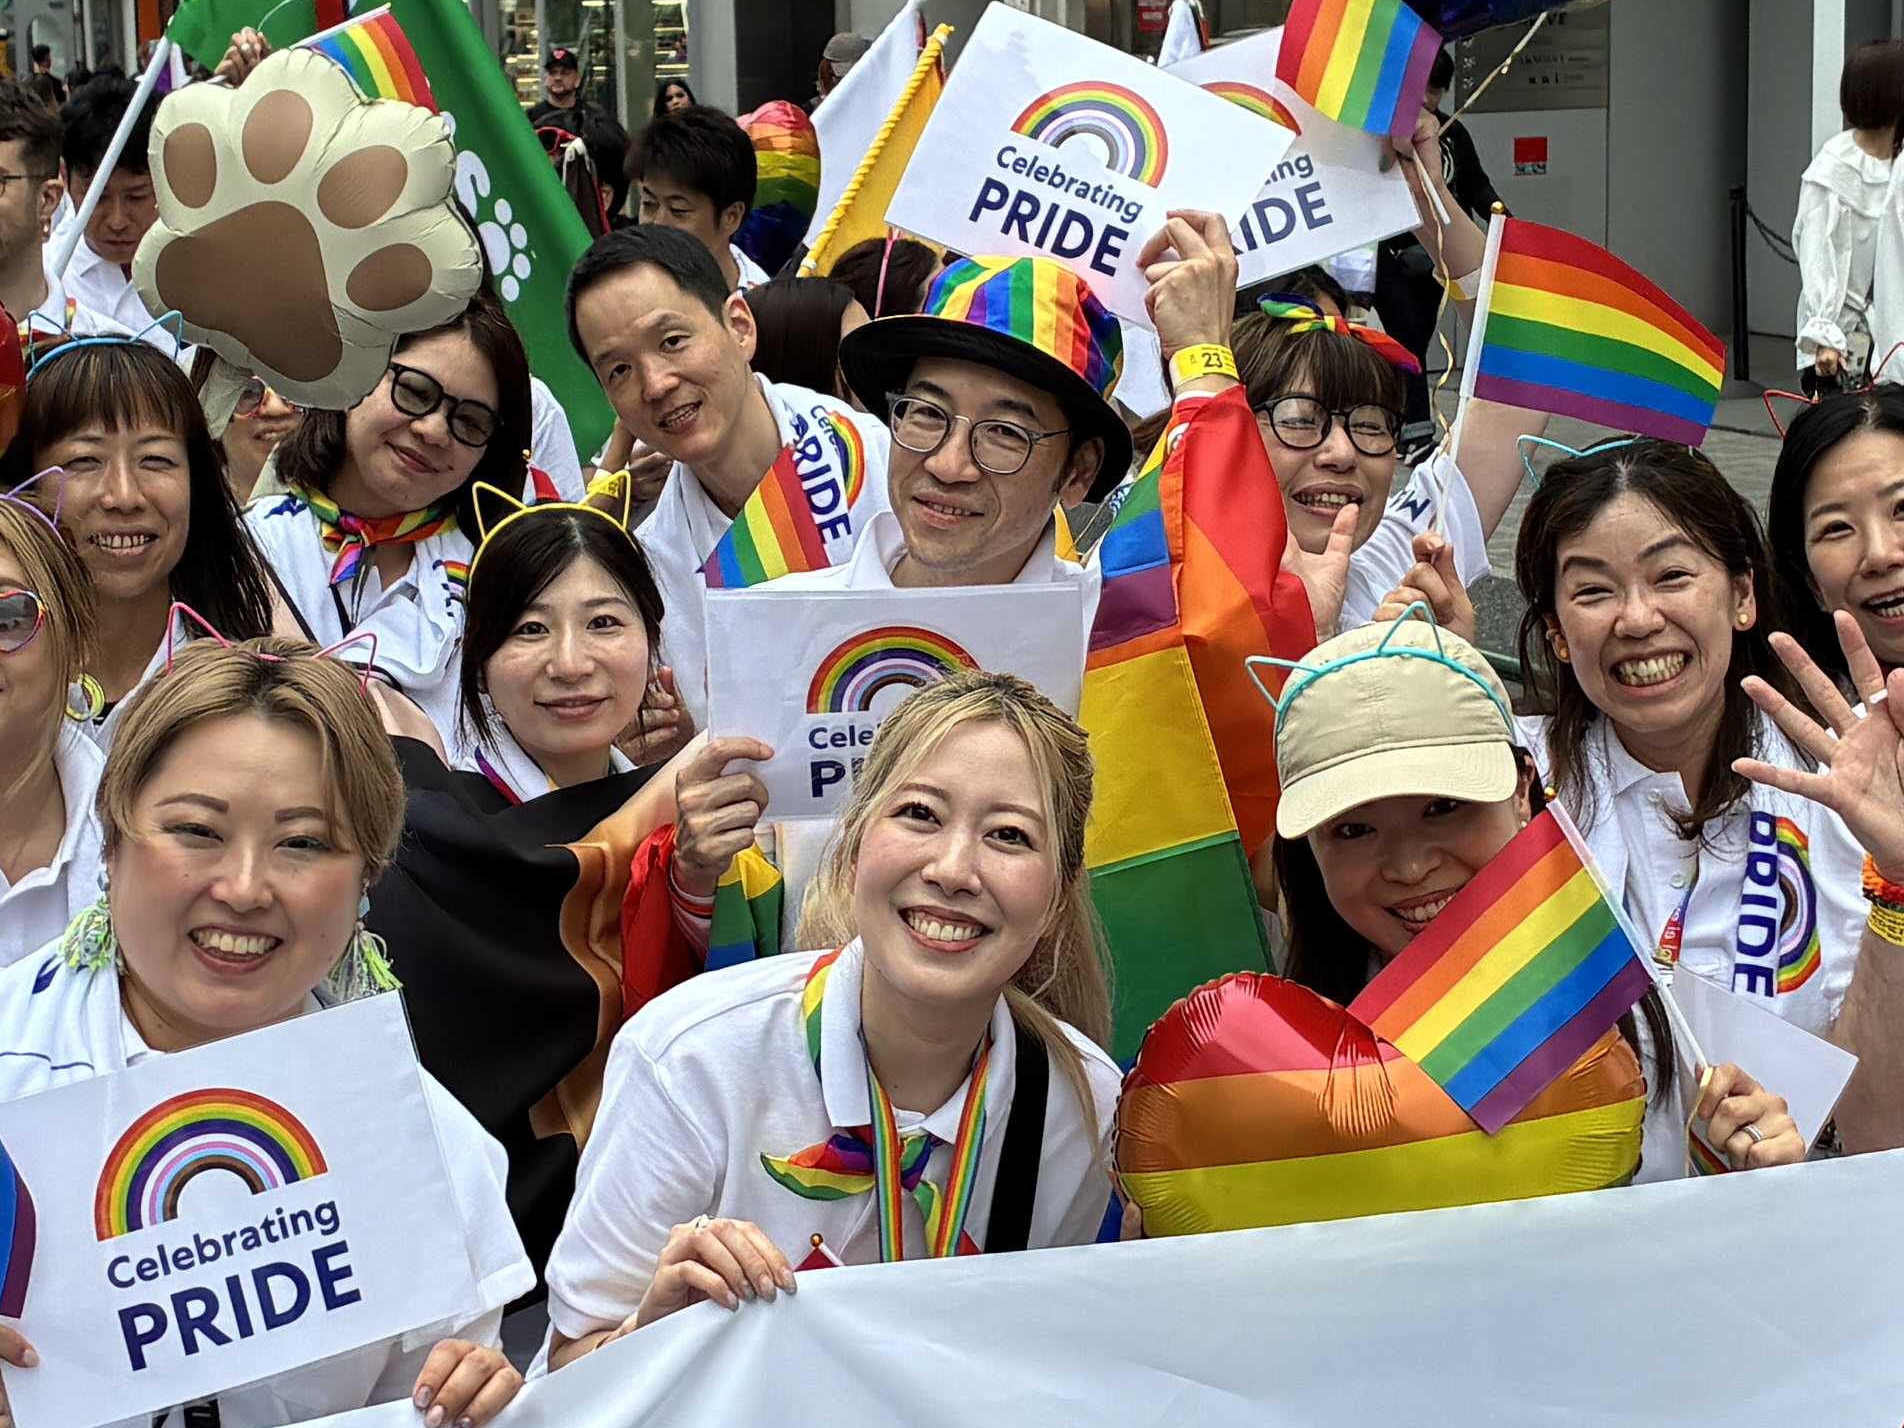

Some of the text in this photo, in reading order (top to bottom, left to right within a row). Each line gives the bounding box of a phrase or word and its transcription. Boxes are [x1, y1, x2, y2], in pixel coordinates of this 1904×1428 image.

[996, 146, 1144, 223] Celebrating
[1233, 181, 1334, 255] IDE
[969, 177, 1130, 277] PRIDE
[1201, 352, 1223, 368] 23
[808, 724, 881, 750] Cele
[107, 1200, 341, 1289] Celebrating
[118, 1240, 362, 1371] PRIDE
